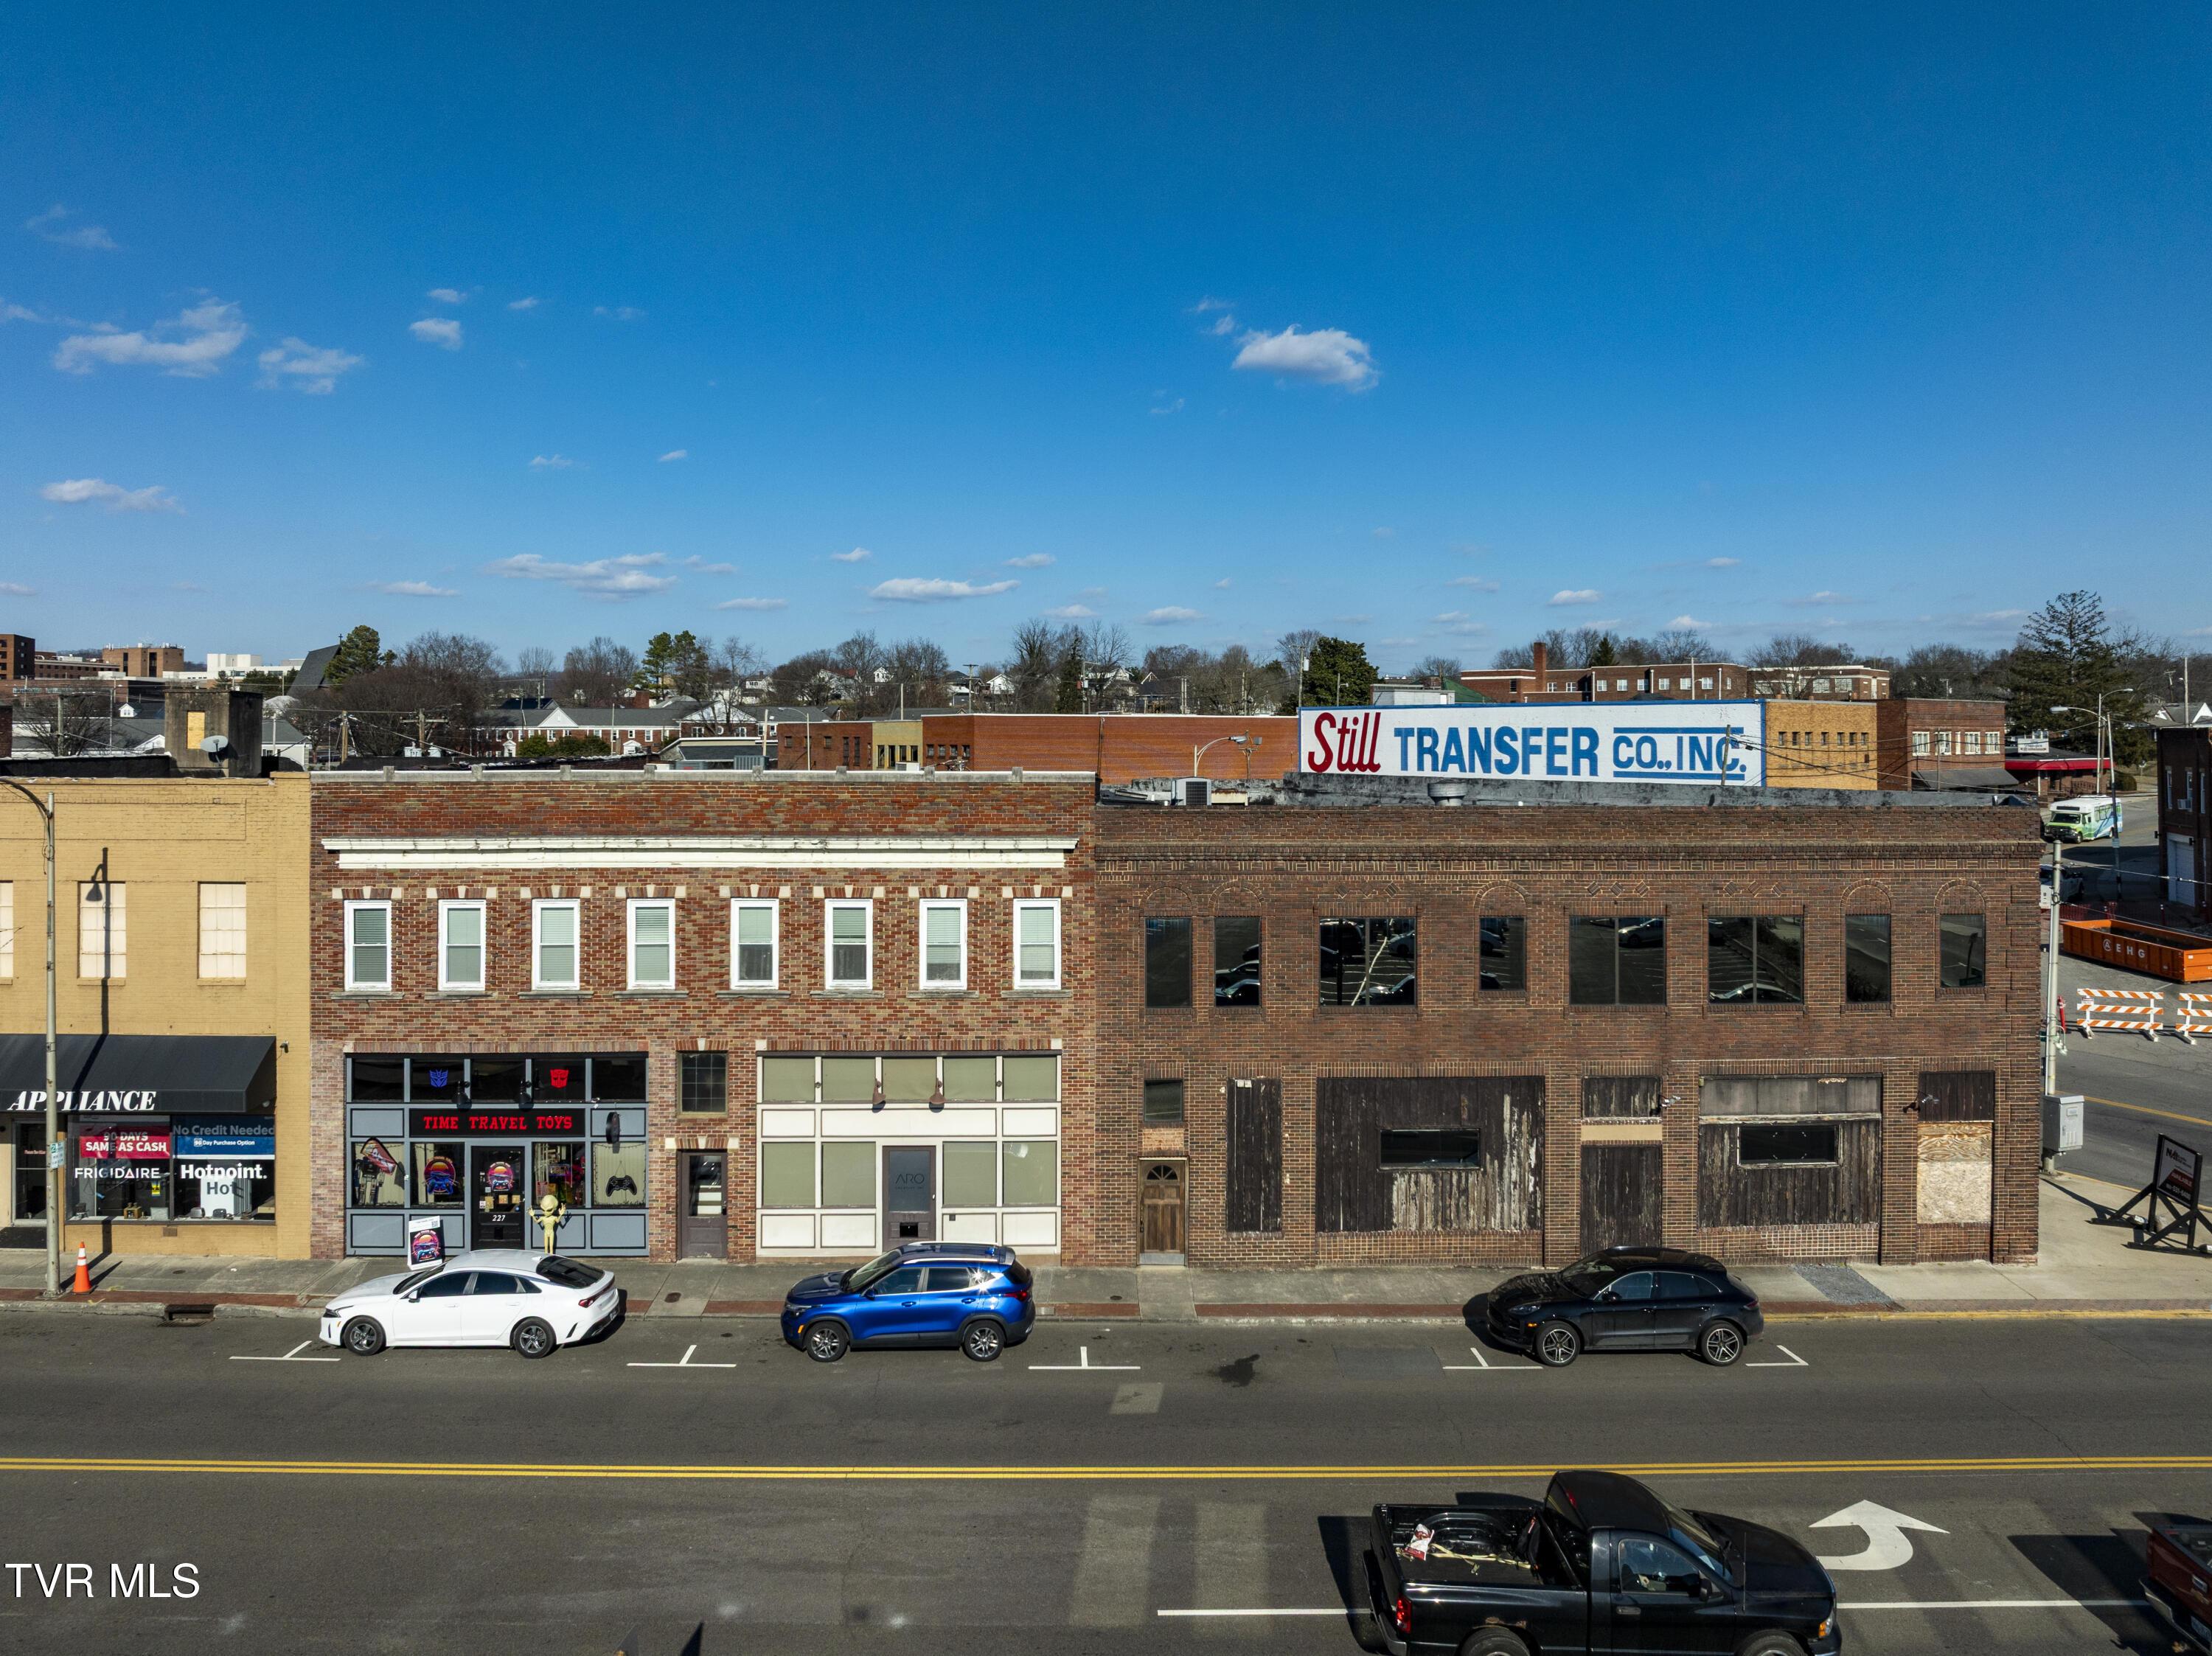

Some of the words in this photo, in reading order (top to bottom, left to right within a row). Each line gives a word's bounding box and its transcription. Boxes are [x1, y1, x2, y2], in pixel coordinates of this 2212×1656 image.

[1307, 712, 1381, 773] Still
[1394, 726, 1599, 776] TRANSFER
[423, 1116, 459, 1130] TIME
[469, 1116, 527, 1130] TRAVEL
[537, 1116, 572, 1130] TOYS
[173, 1125, 189, 1135] No
[192, 1124, 227, 1135] Credit
[104, 1132, 117, 1141] 90
[120, 1132, 148, 1141] DAYS
[86, 1142, 116, 1152] SAME
[118, 1142, 133, 1152] AS
[136, 1142, 167, 1152] CASH
[74, 1167, 161, 1179] FRIGIDAIRE
[895, 1173, 925, 1186] ARO
